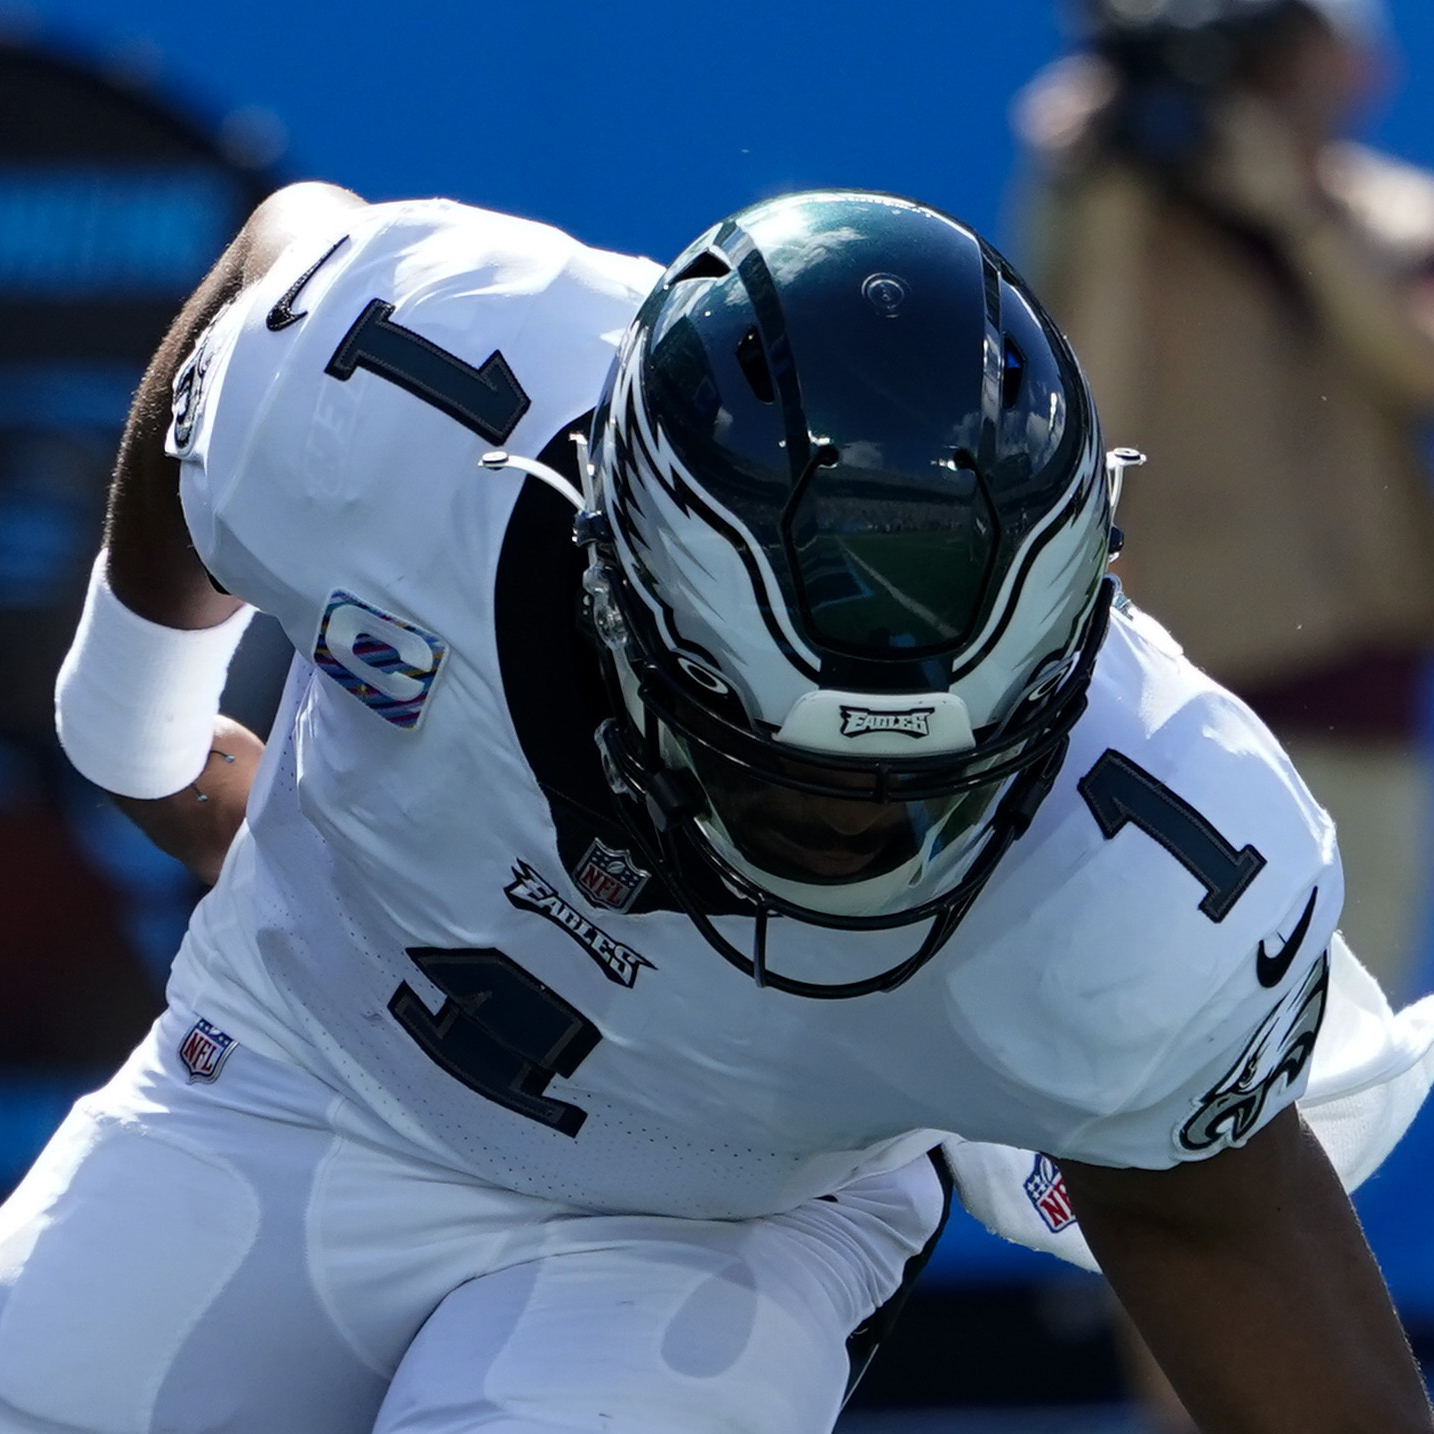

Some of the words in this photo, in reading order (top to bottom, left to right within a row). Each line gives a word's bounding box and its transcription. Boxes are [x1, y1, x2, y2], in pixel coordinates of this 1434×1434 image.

[324, 297, 531, 446] 1
[840, 705, 935, 738] EAGLES
[1076, 747, 1267, 924] 1
[503, 858, 658, 988] EAGLES
[580, 865, 624, 906] NFL
[183, 1031, 218, 1071] NFL
